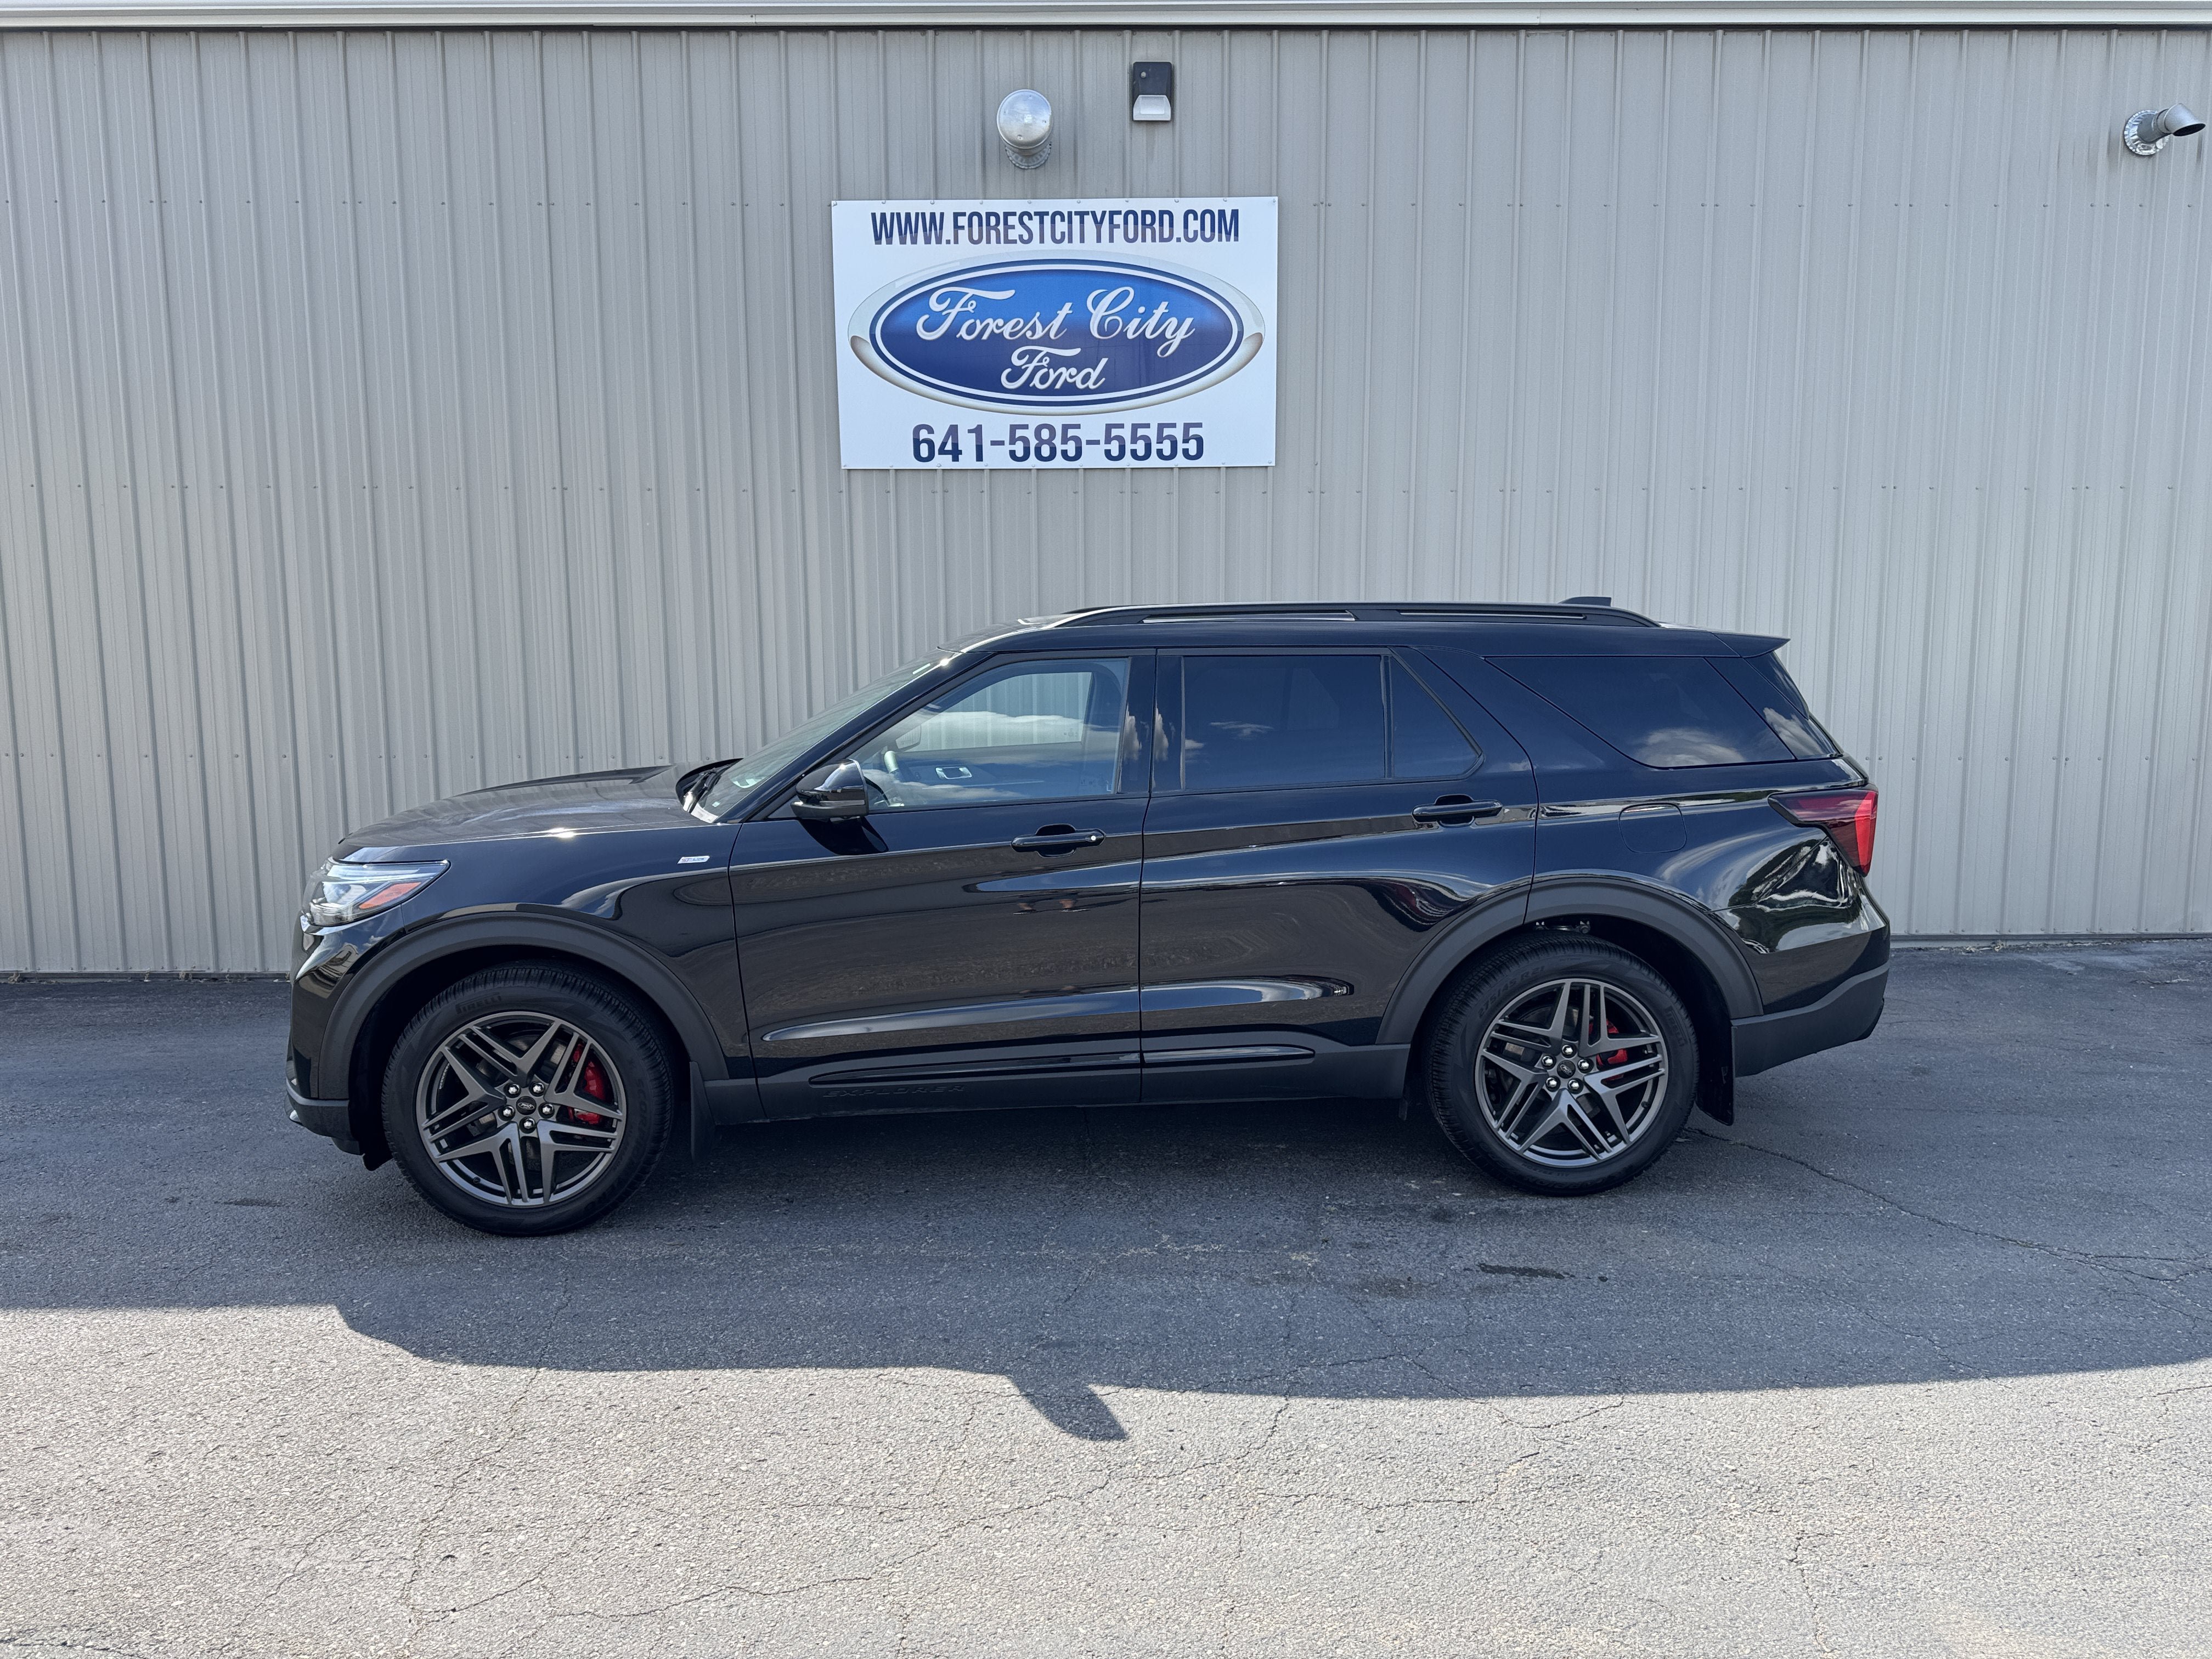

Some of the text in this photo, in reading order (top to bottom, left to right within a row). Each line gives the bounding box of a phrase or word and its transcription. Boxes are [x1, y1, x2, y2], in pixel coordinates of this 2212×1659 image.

[871, 209, 1239, 245] WWW.FORESTCITYFORD.COM
[916, 286, 1195, 358] Forest City
[1001, 346, 1108, 390] Ford
[912, 422, 1204, 463] 641-585-5555
[456, 993, 501, 1014] PIRELLI
[823, 1086, 965, 1098] EXPLORER
